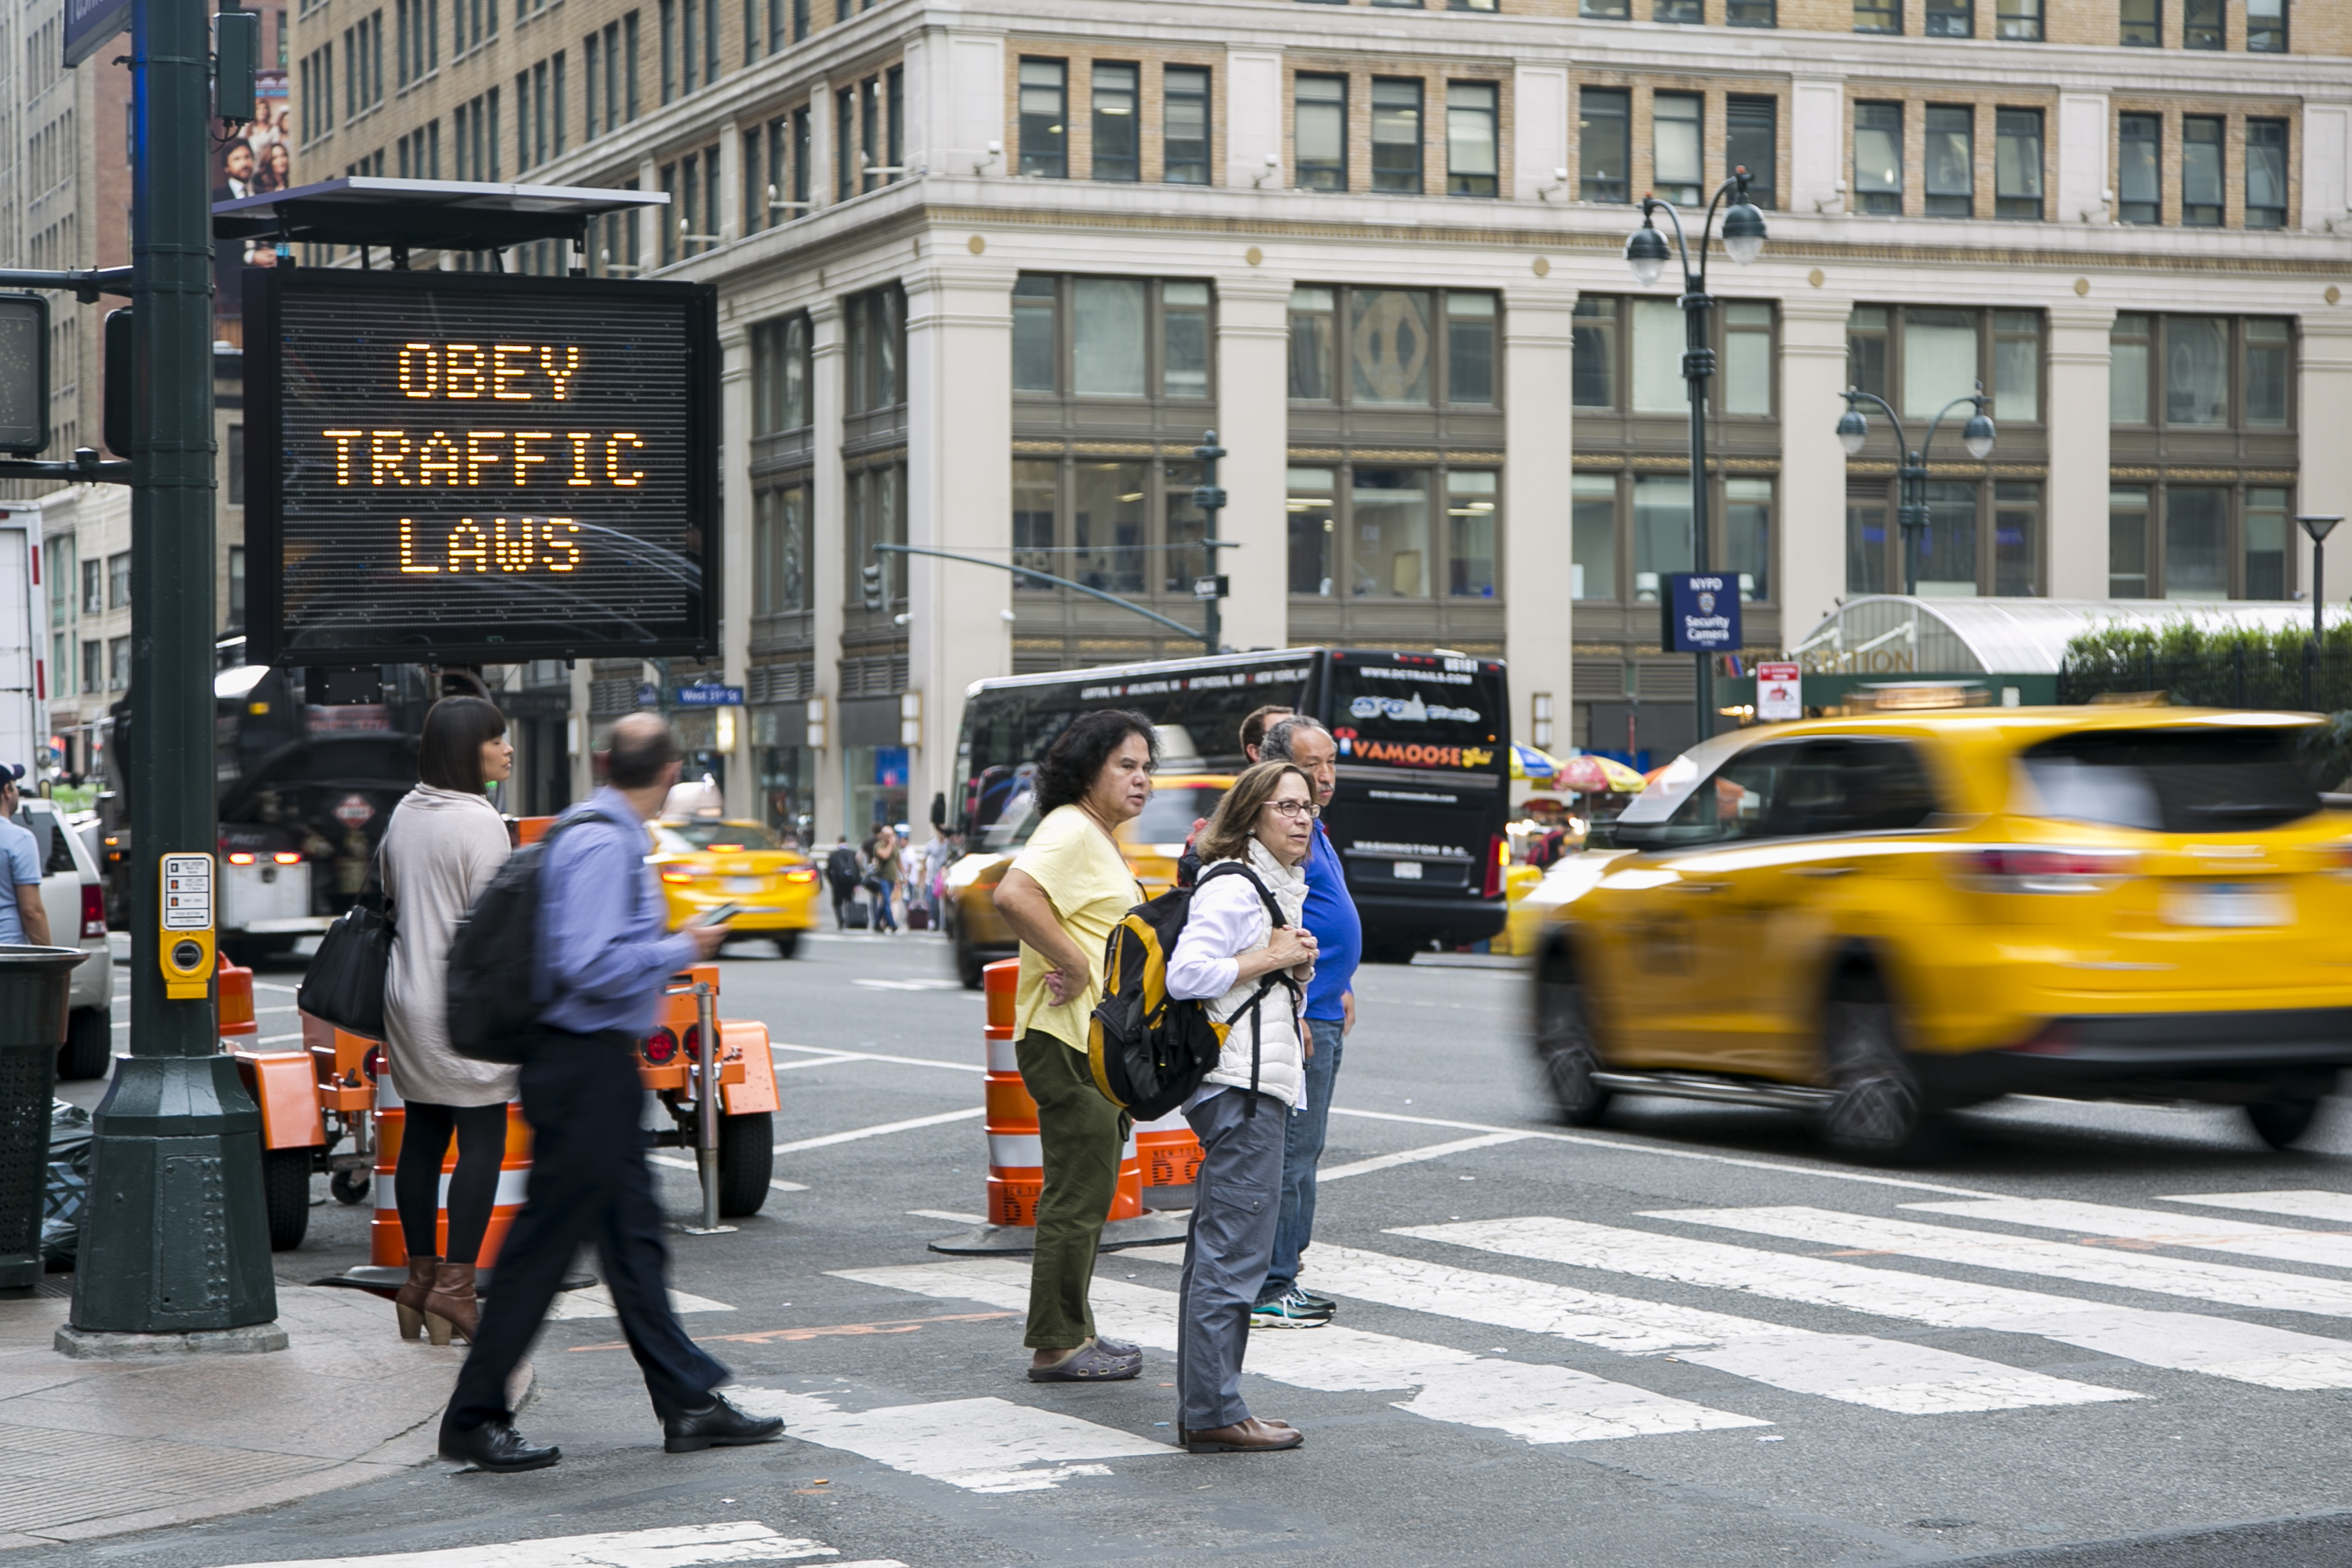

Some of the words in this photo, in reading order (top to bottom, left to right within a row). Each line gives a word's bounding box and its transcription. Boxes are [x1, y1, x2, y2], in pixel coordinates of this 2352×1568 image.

[399, 343, 579, 400] OBEY
[323, 430, 644, 485] TRAFFIC
[400, 518, 580, 573] LAWS
[1690, 577, 1723, 591] NYPD
[1685, 615, 1730, 629] Security
[1686, 628, 1729, 641] Camera
[1360, 666, 1472, 686] WWW.DCTRAILS.COM
[682, 689, 706, 701] West
[727, 689, 739, 702] St
[1352, 740, 1461, 767] VAMOOSE
[1352, 840, 1440, 856] WASHINGTON
[1003, 1186, 1021, 1195] NEW
[1027, 1186, 1041, 1195] YO
